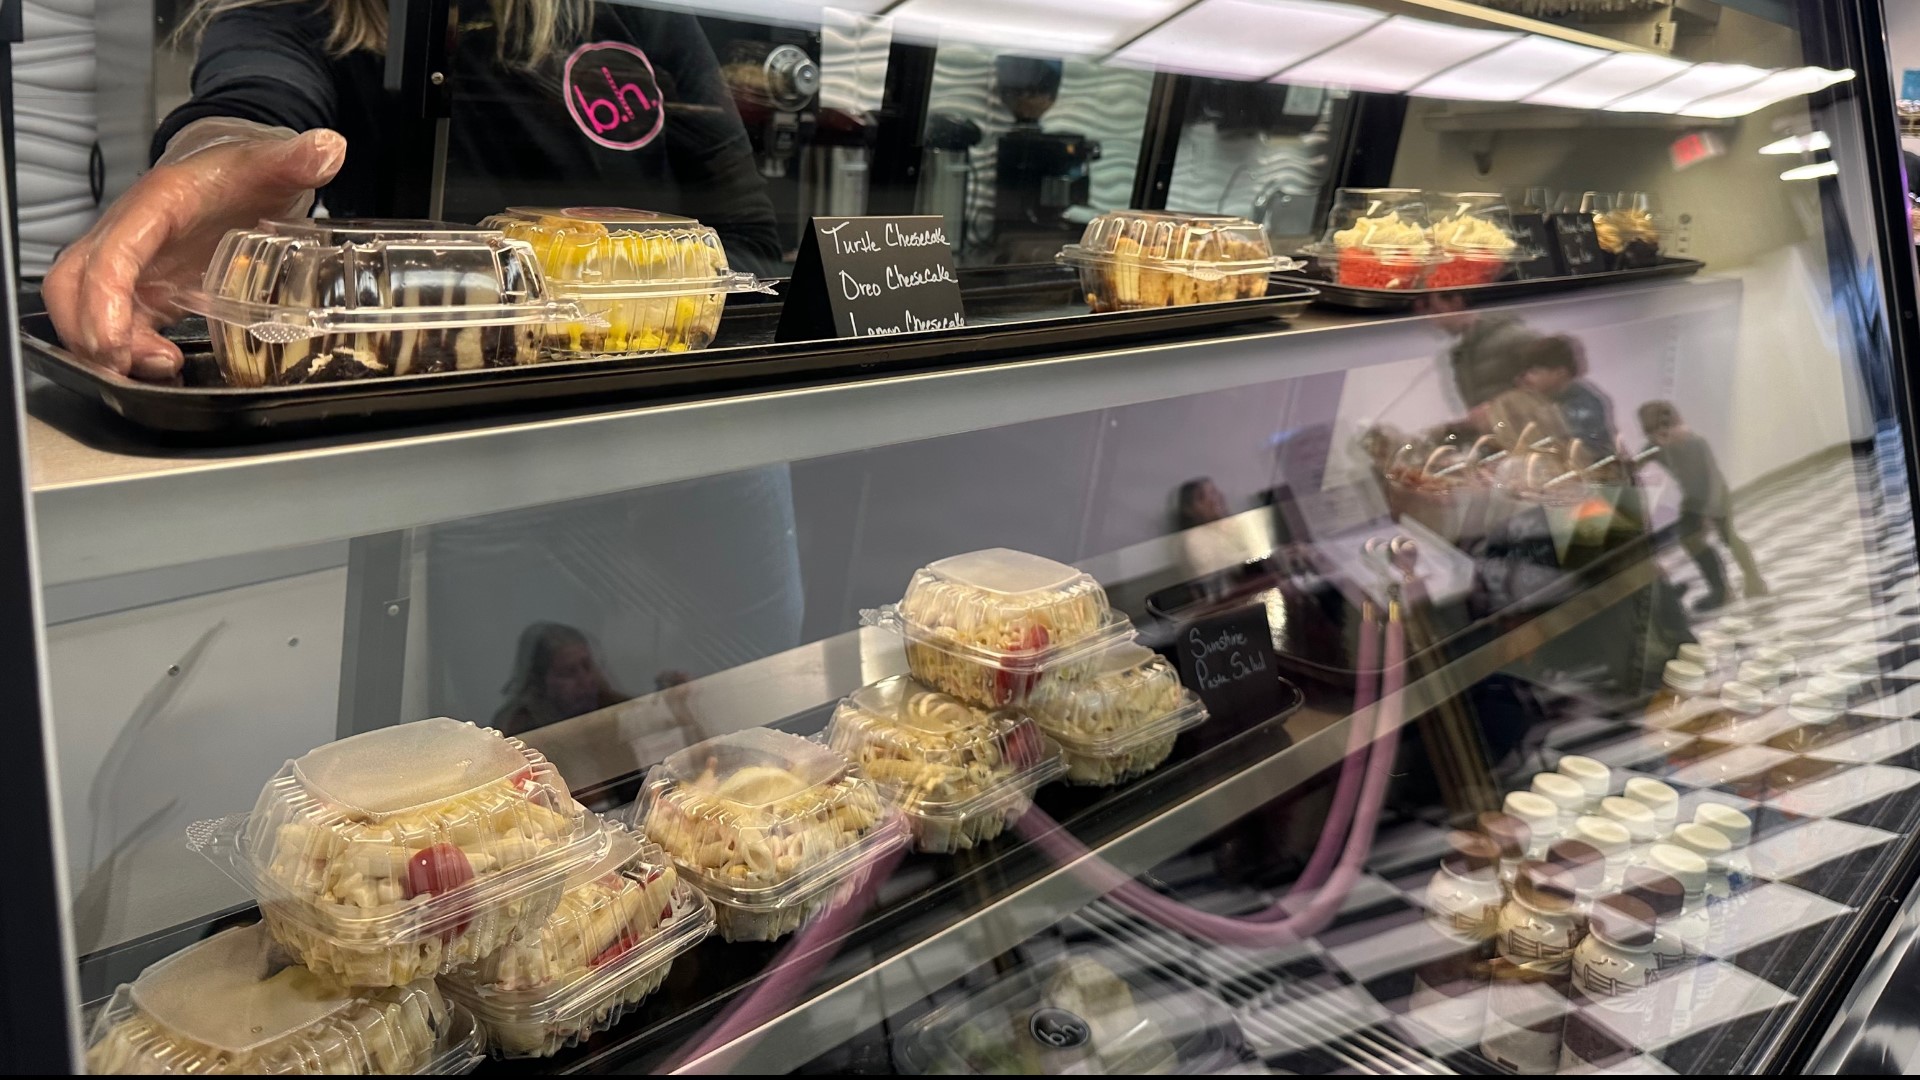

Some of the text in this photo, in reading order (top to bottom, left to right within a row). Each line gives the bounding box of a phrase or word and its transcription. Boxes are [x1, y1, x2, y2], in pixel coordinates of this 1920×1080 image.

[820, 221, 952, 255] Turtle Cheesecake
[838, 263, 958, 301] Oreo Cheesecake
[1189, 625, 1248, 659] Sunshine
[1195, 650, 1267, 690] Pasta Salad
